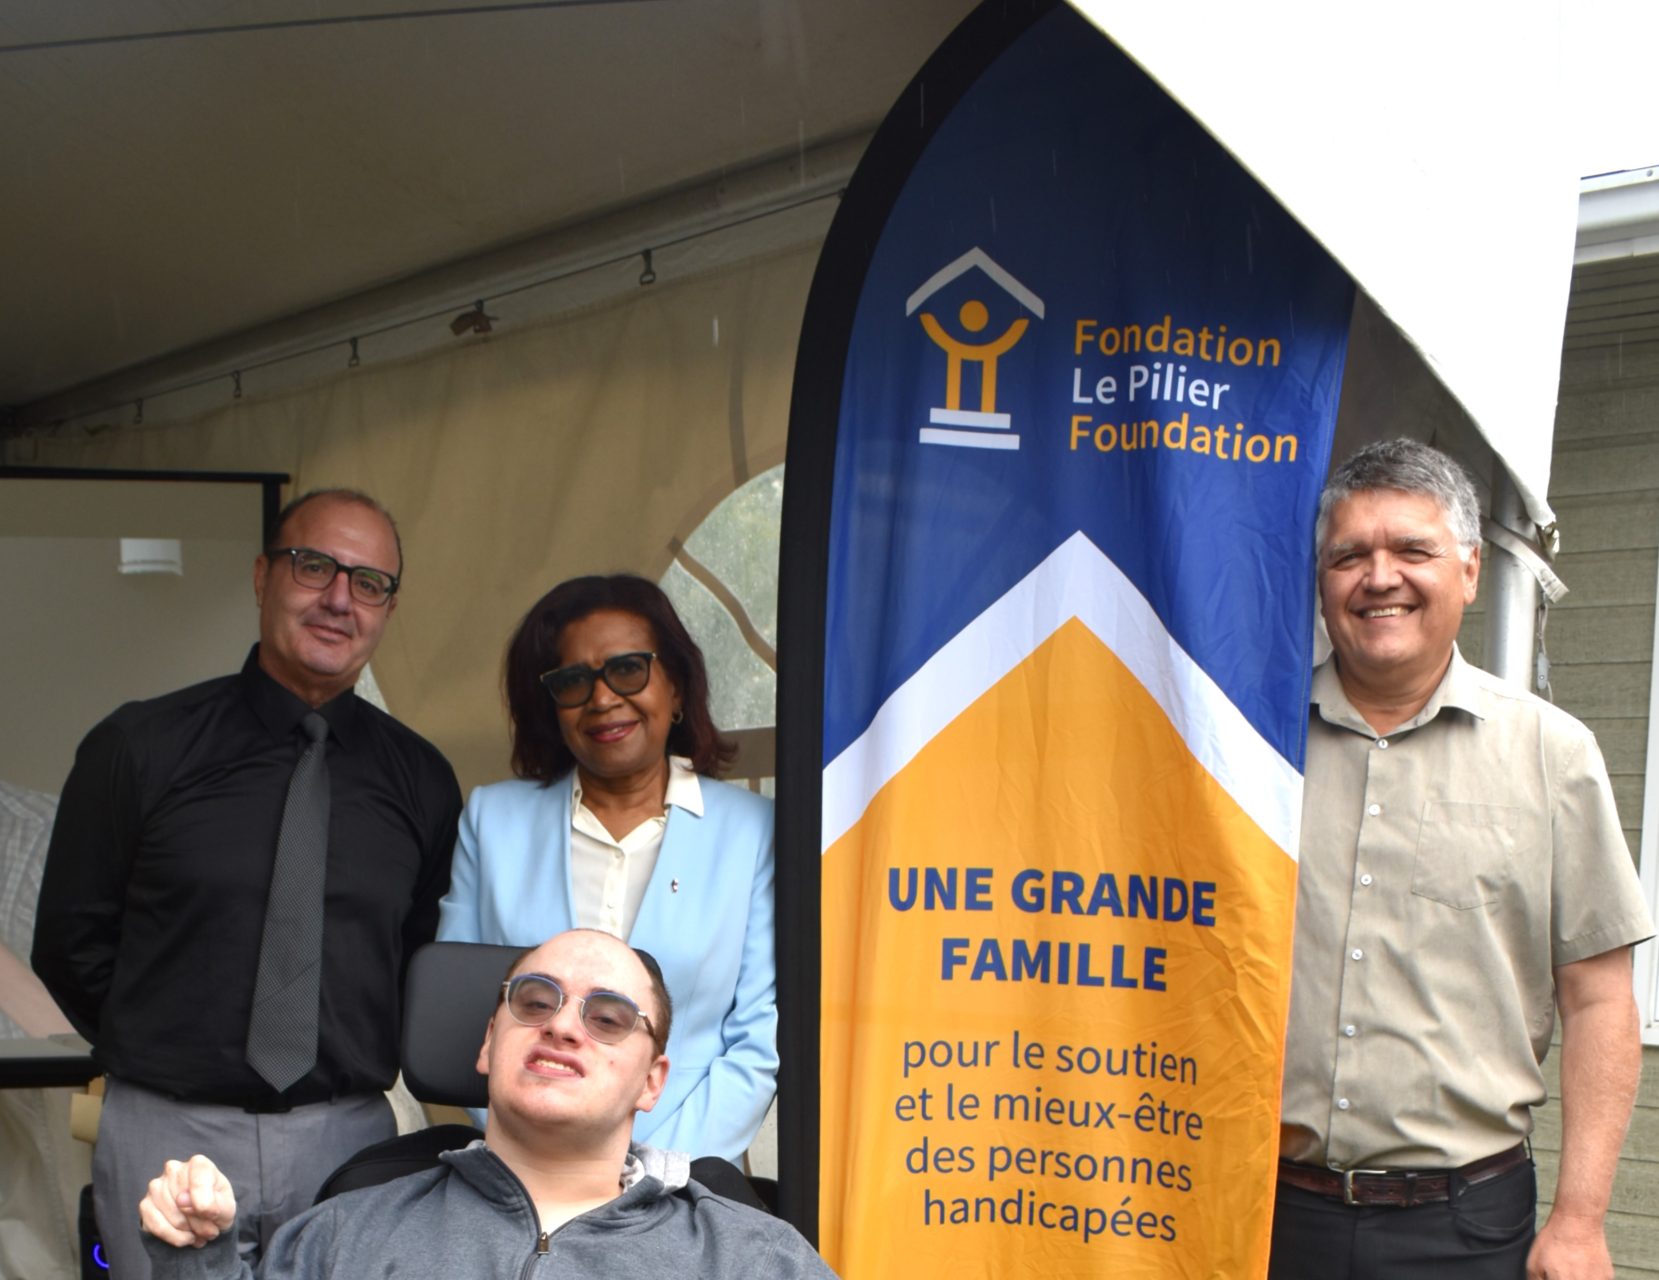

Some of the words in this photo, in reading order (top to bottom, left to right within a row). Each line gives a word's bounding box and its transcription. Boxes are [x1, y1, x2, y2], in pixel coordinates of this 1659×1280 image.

[1075, 314, 1281, 367] Fondation
[1072, 367, 1117, 404] Le
[1129, 362, 1230, 410] Pilier
[1070, 412, 1298, 462] Foundation
[888, 867, 994, 912] UNE
[1011, 868, 1217, 927] GRANDE
[941, 938, 1167, 992] FAMILLE
[903, 1039, 1000, 1078] pour
[1013, 1031, 1045, 1069] le
[1056, 1042, 1198, 1085] soutien
[894, 1087, 933, 1122] et
[947, 1083, 980, 1121] le
[993, 1086, 1204, 1141] mieux-être
[905, 1137, 975, 1174] des
[988, 1145, 1192, 1192] personnes
[923, 1189, 1177, 1243] handicapées
